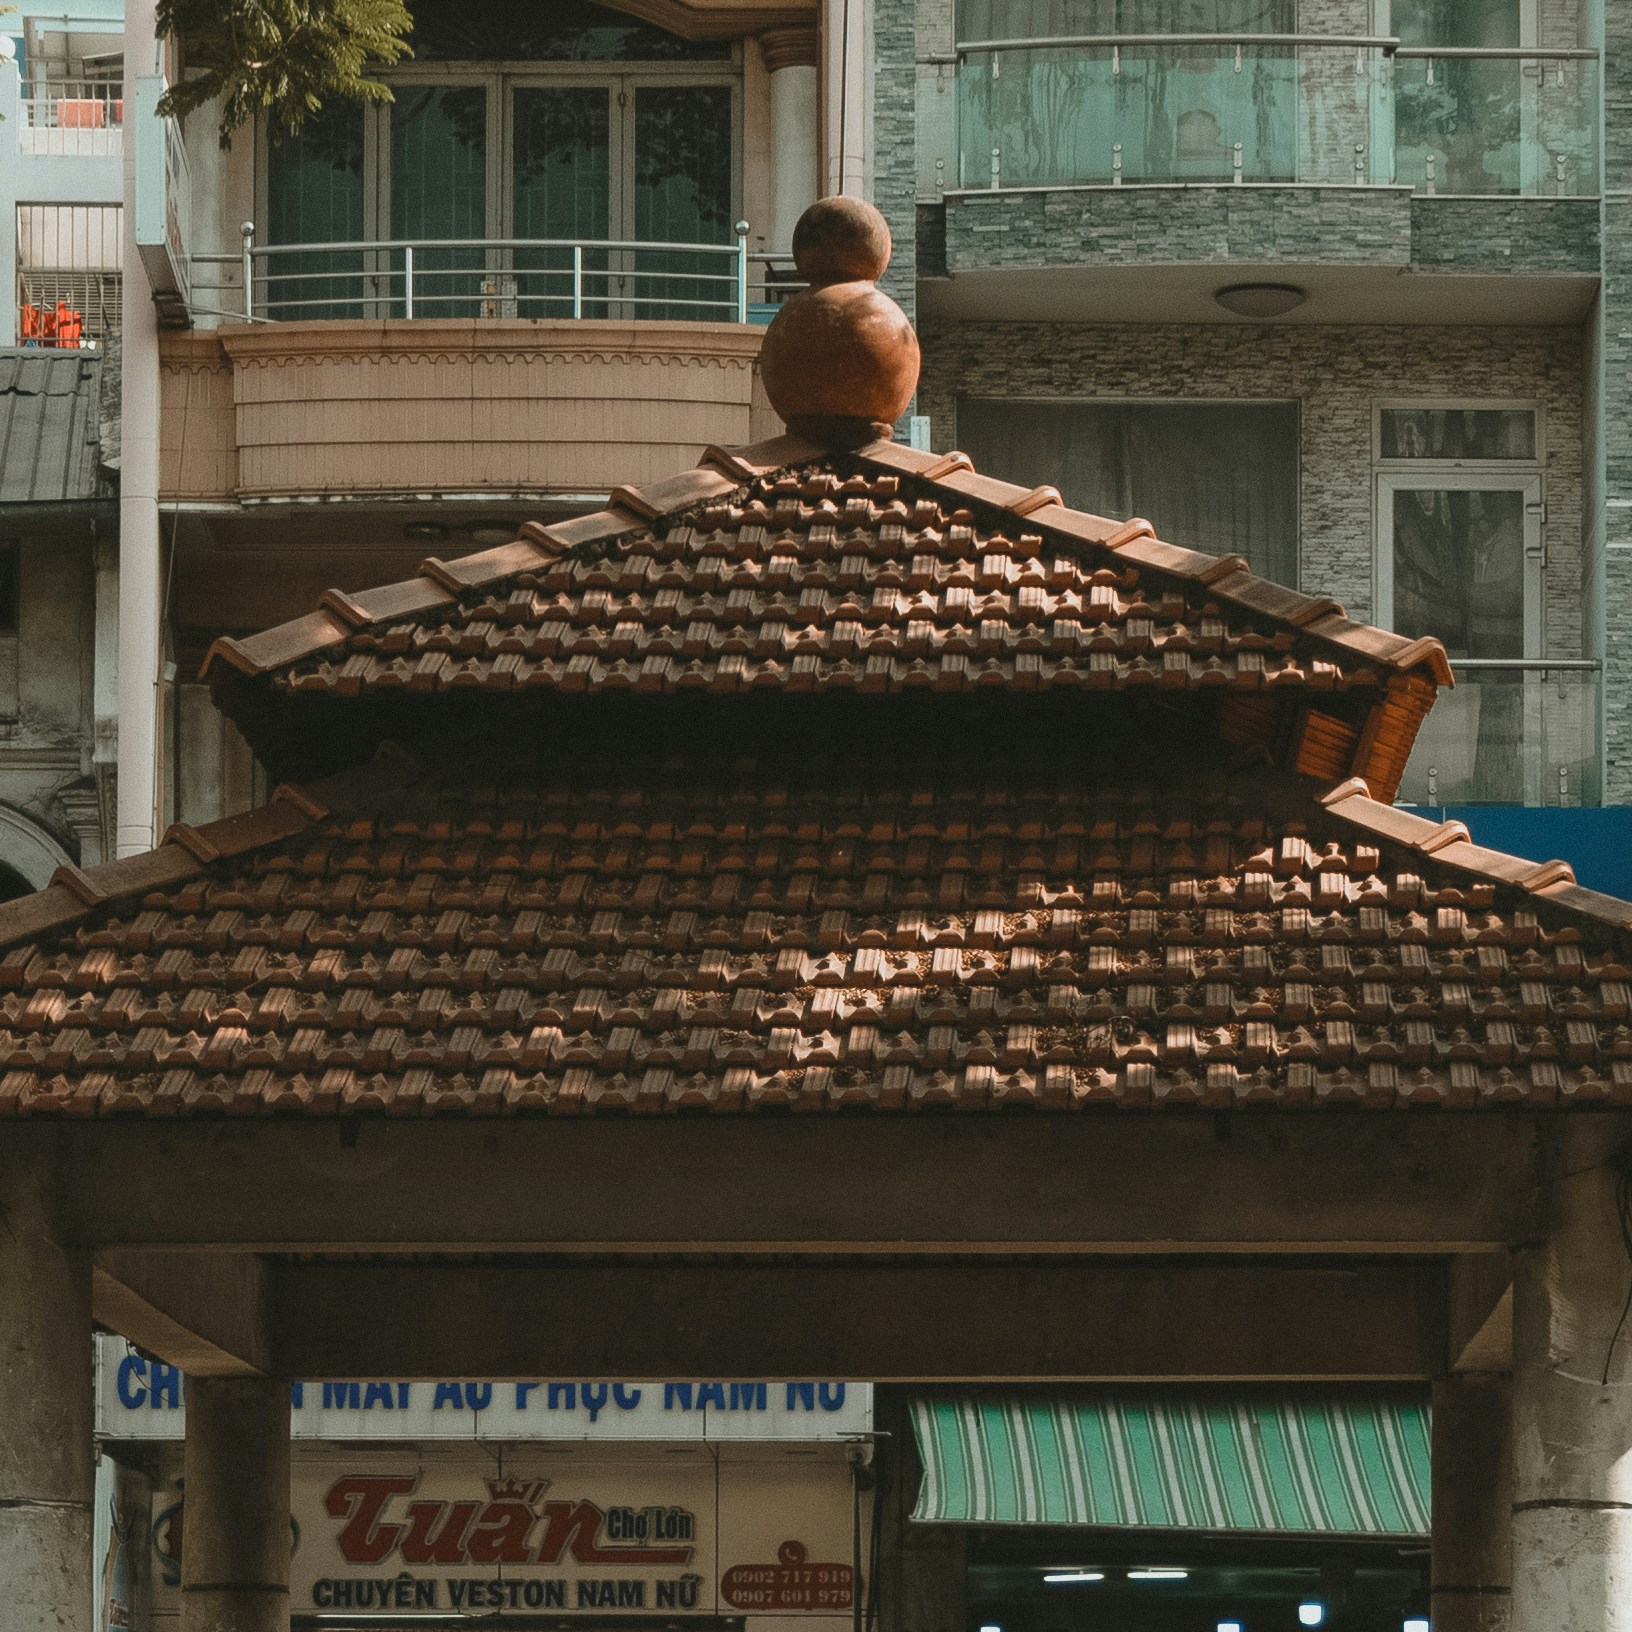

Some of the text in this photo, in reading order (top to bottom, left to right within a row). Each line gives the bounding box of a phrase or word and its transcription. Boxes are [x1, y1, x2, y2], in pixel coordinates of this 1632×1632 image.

[607, 1507, 650, 1546] Chợ
[653, 1507, 696, 1541] Lớn
[312, 1571, 438, 1609] CHUYÊN
[446, 1578, 569, 1609] VESTON
[576, 1578, 646, 1608] NAM
[780, 1569, 814, 1584] 717
